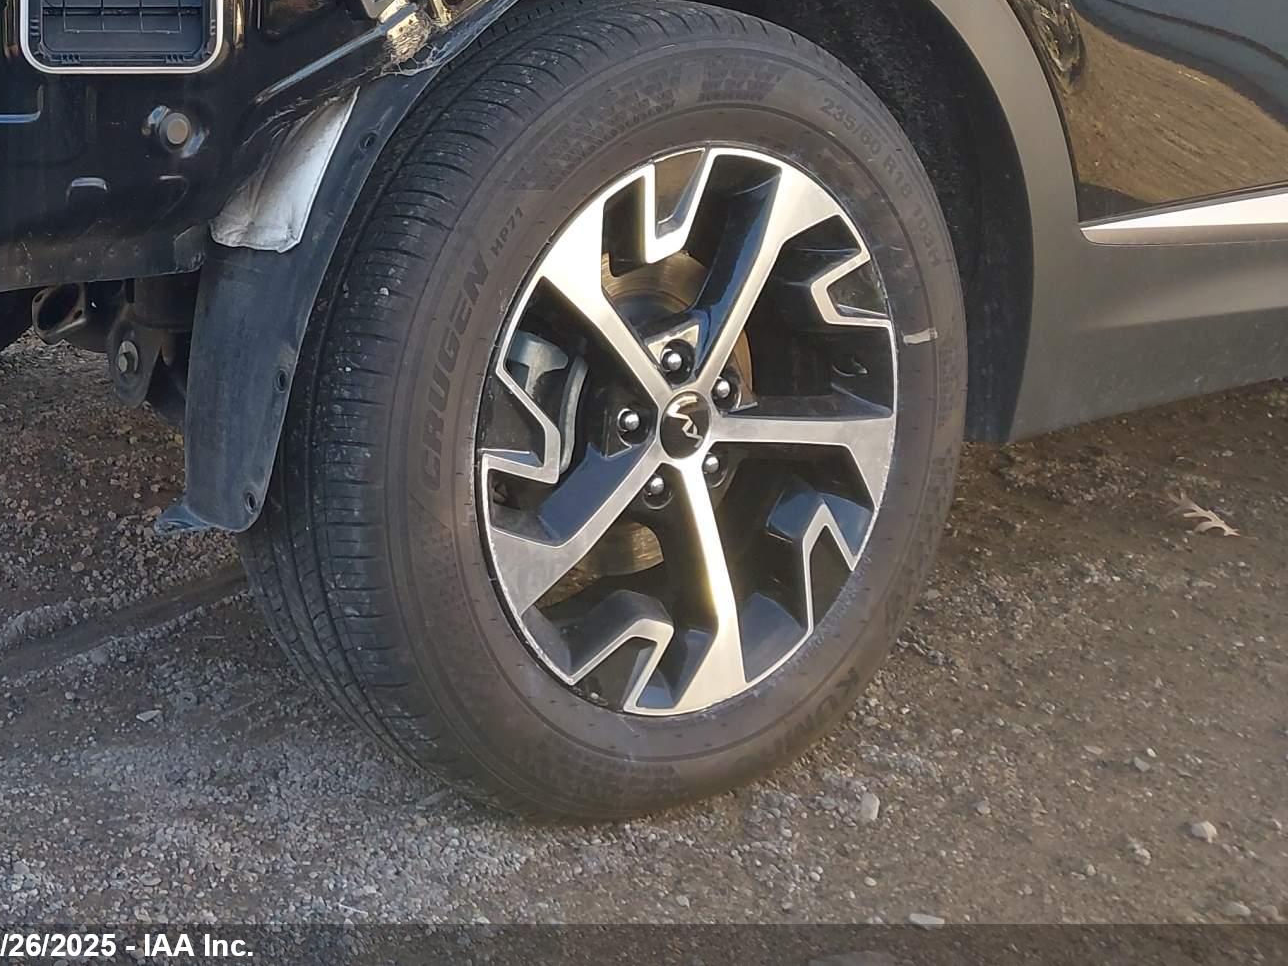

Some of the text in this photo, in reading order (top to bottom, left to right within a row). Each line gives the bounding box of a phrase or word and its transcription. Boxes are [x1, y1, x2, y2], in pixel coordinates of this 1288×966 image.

[819, 96, 882, 155] 235/60
[881, 153, 913, 199] R18
[420, 204, 526, 492] CRUGEN HP71
